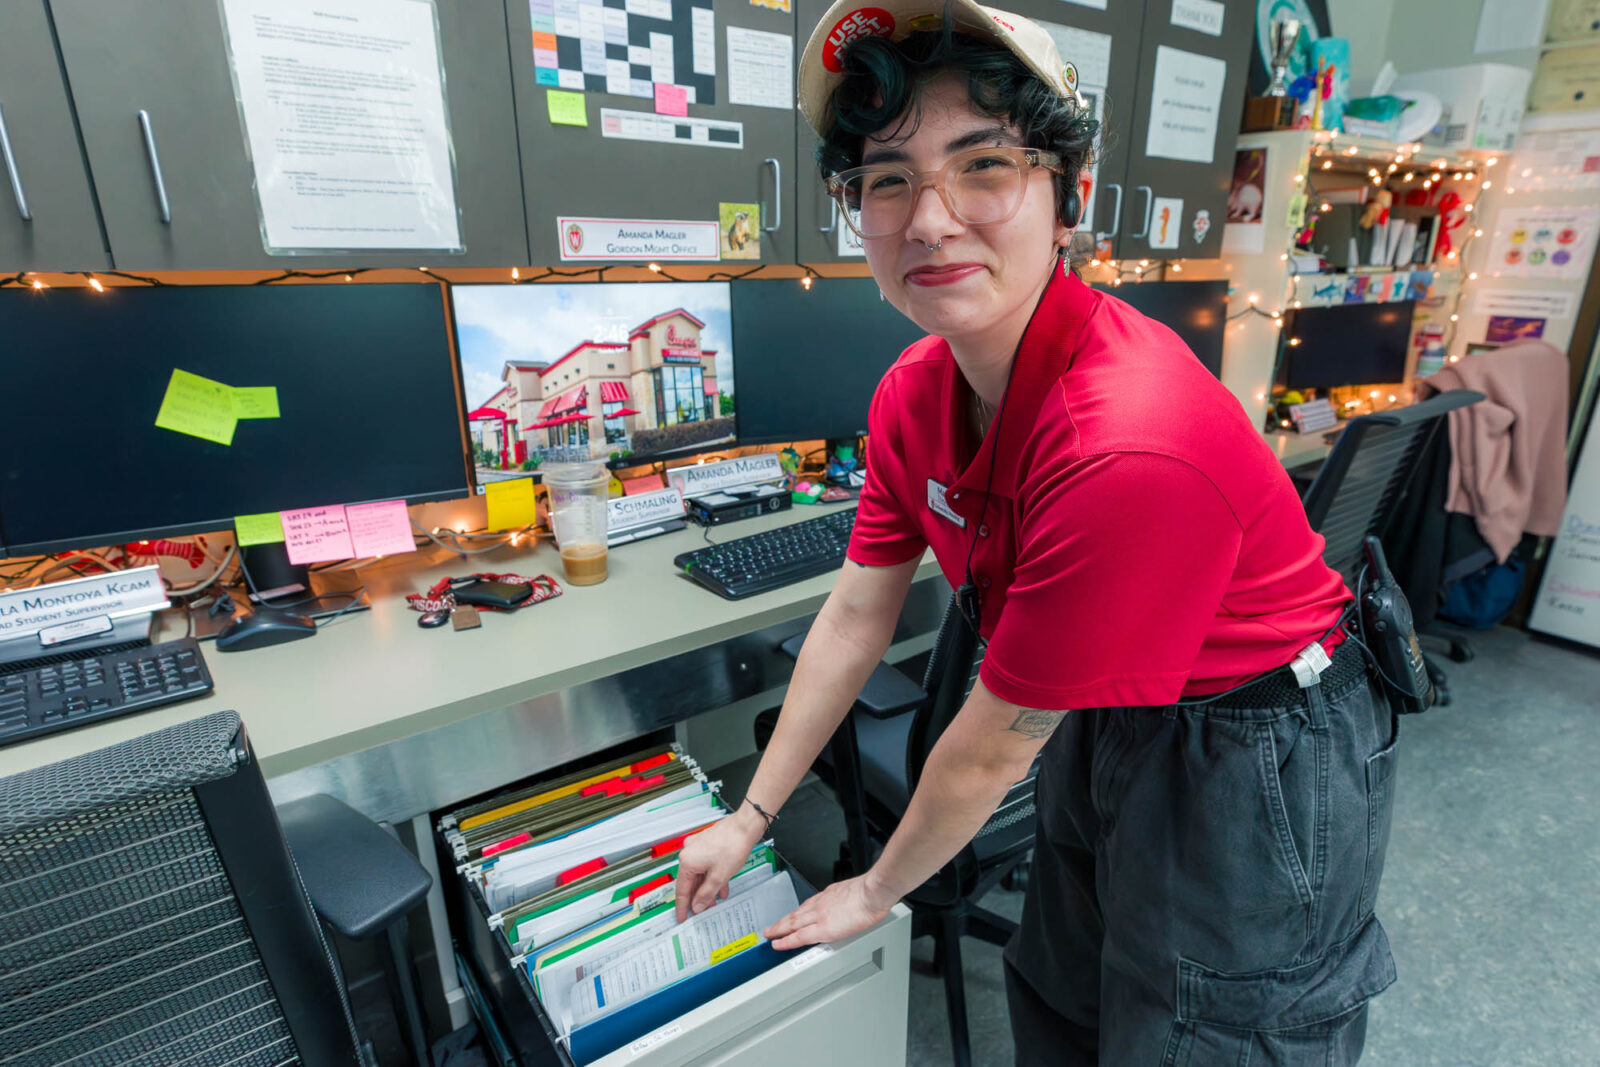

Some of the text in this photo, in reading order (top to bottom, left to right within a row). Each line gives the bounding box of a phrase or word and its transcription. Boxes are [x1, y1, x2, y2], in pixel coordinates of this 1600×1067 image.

[828, 11, 867, 46] USE
[617, 229, 687, 240] AMANDA MAGLER
[606, 243, 698, 254] GORDON MGMT OFFICE
[687, 458, 777, 482] AMANDA MAGLER
[614, 494, 677, 515] SCHMALING
[23, 589, 103, 612] MONTOYA
[106, 580, 151, 595] KCAM
[15, 612, 62, 626] STUDENT
[65, 600, 123, 617] SUPERVISOR
